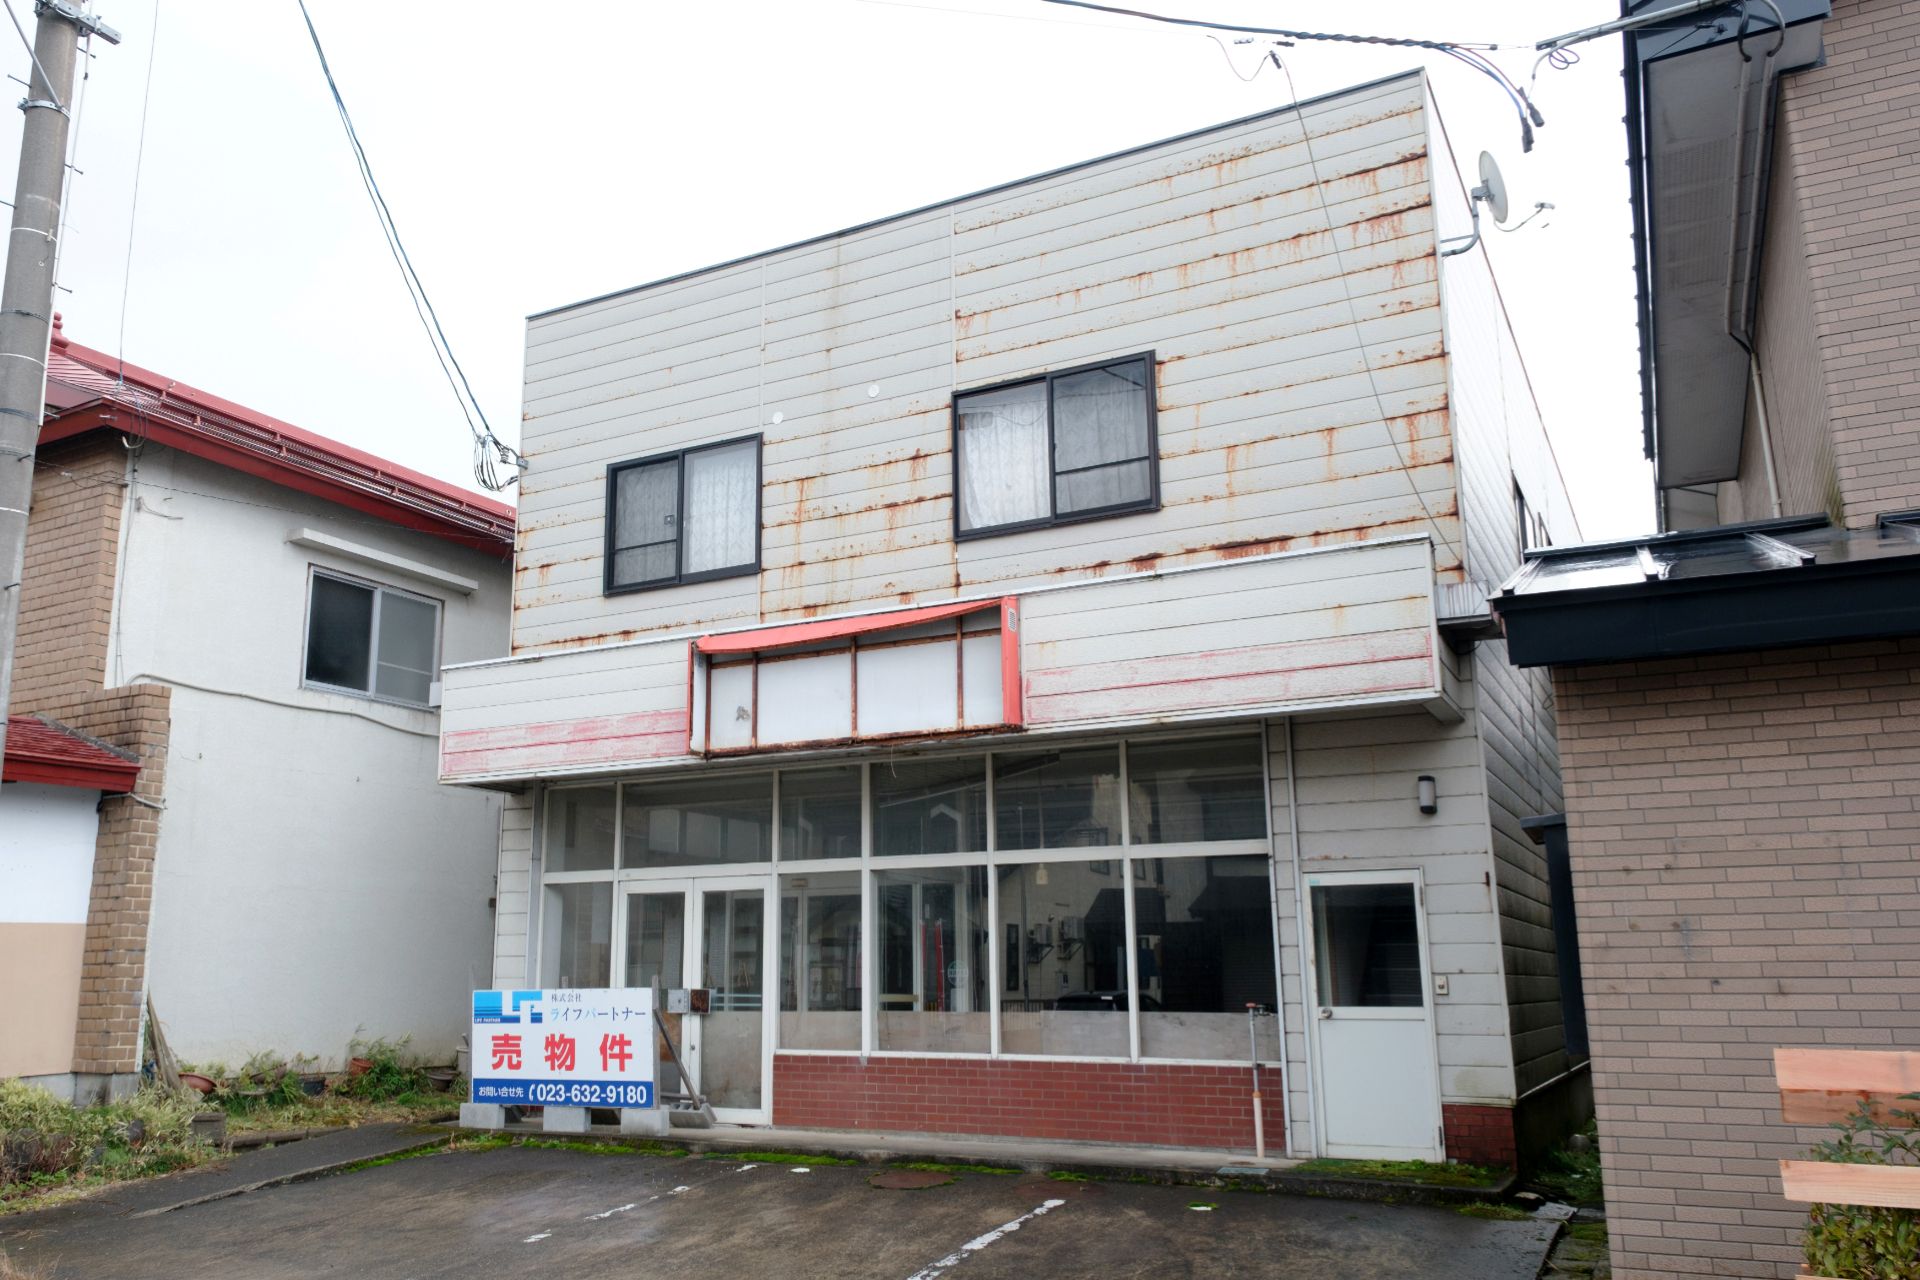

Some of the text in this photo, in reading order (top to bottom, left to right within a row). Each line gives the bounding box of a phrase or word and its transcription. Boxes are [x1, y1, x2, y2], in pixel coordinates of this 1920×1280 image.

[552, 993, 582, 1003] 株式会社
[551, 1007, 646, 1022] ライフパートナー
[491, 1034, 633, 1072] 売物件
[478, 1086, 524, 1098] お問い合せ先
[536, 1083, 647, 1104] 023-632-9180
